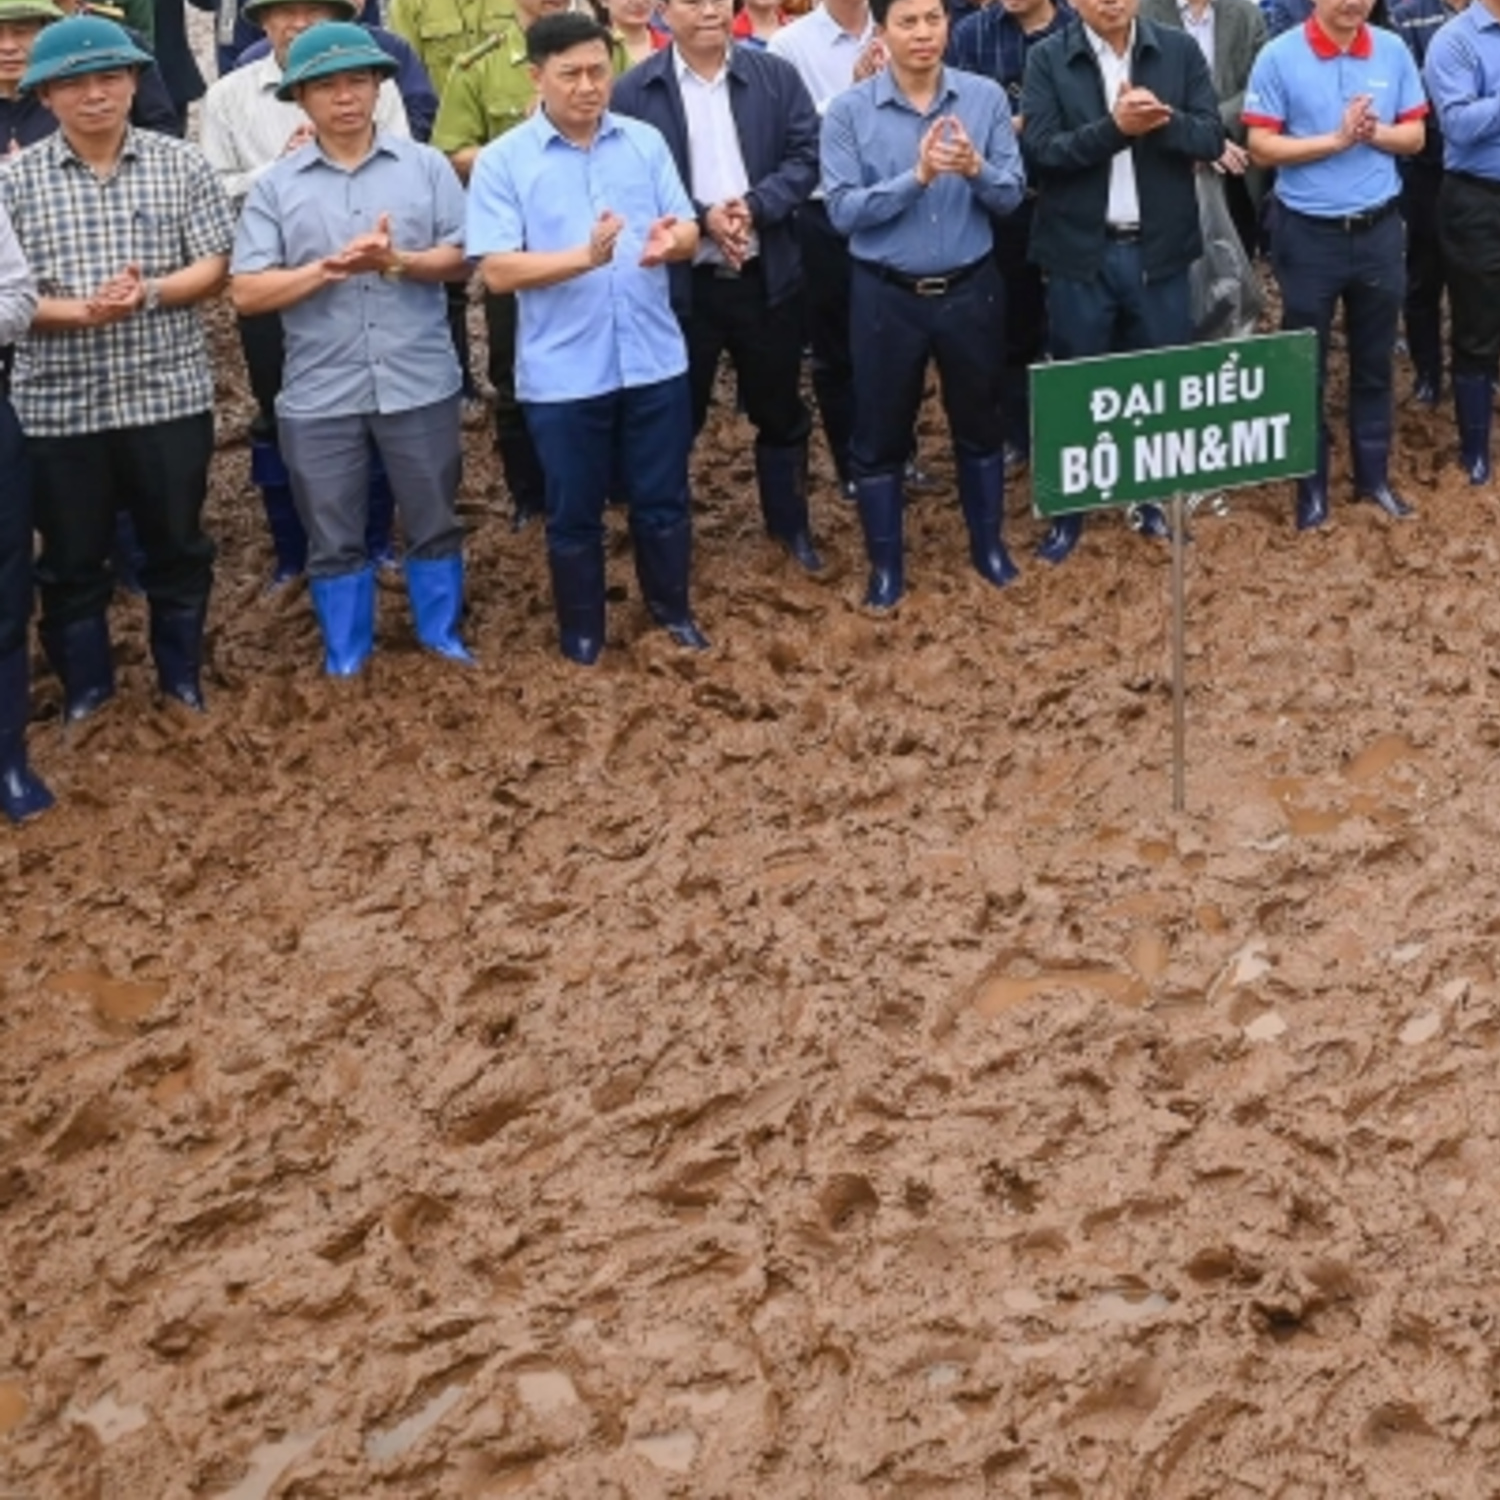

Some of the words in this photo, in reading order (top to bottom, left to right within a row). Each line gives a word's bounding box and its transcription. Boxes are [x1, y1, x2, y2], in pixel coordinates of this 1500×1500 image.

[1089, 379, 1165, 427] ĐẠI
[1179, 351, 1264, 410] BIỂU
[1060, 431, 1119, 500] BỘ
[1134, 413, 1290, 483] NN&MT
